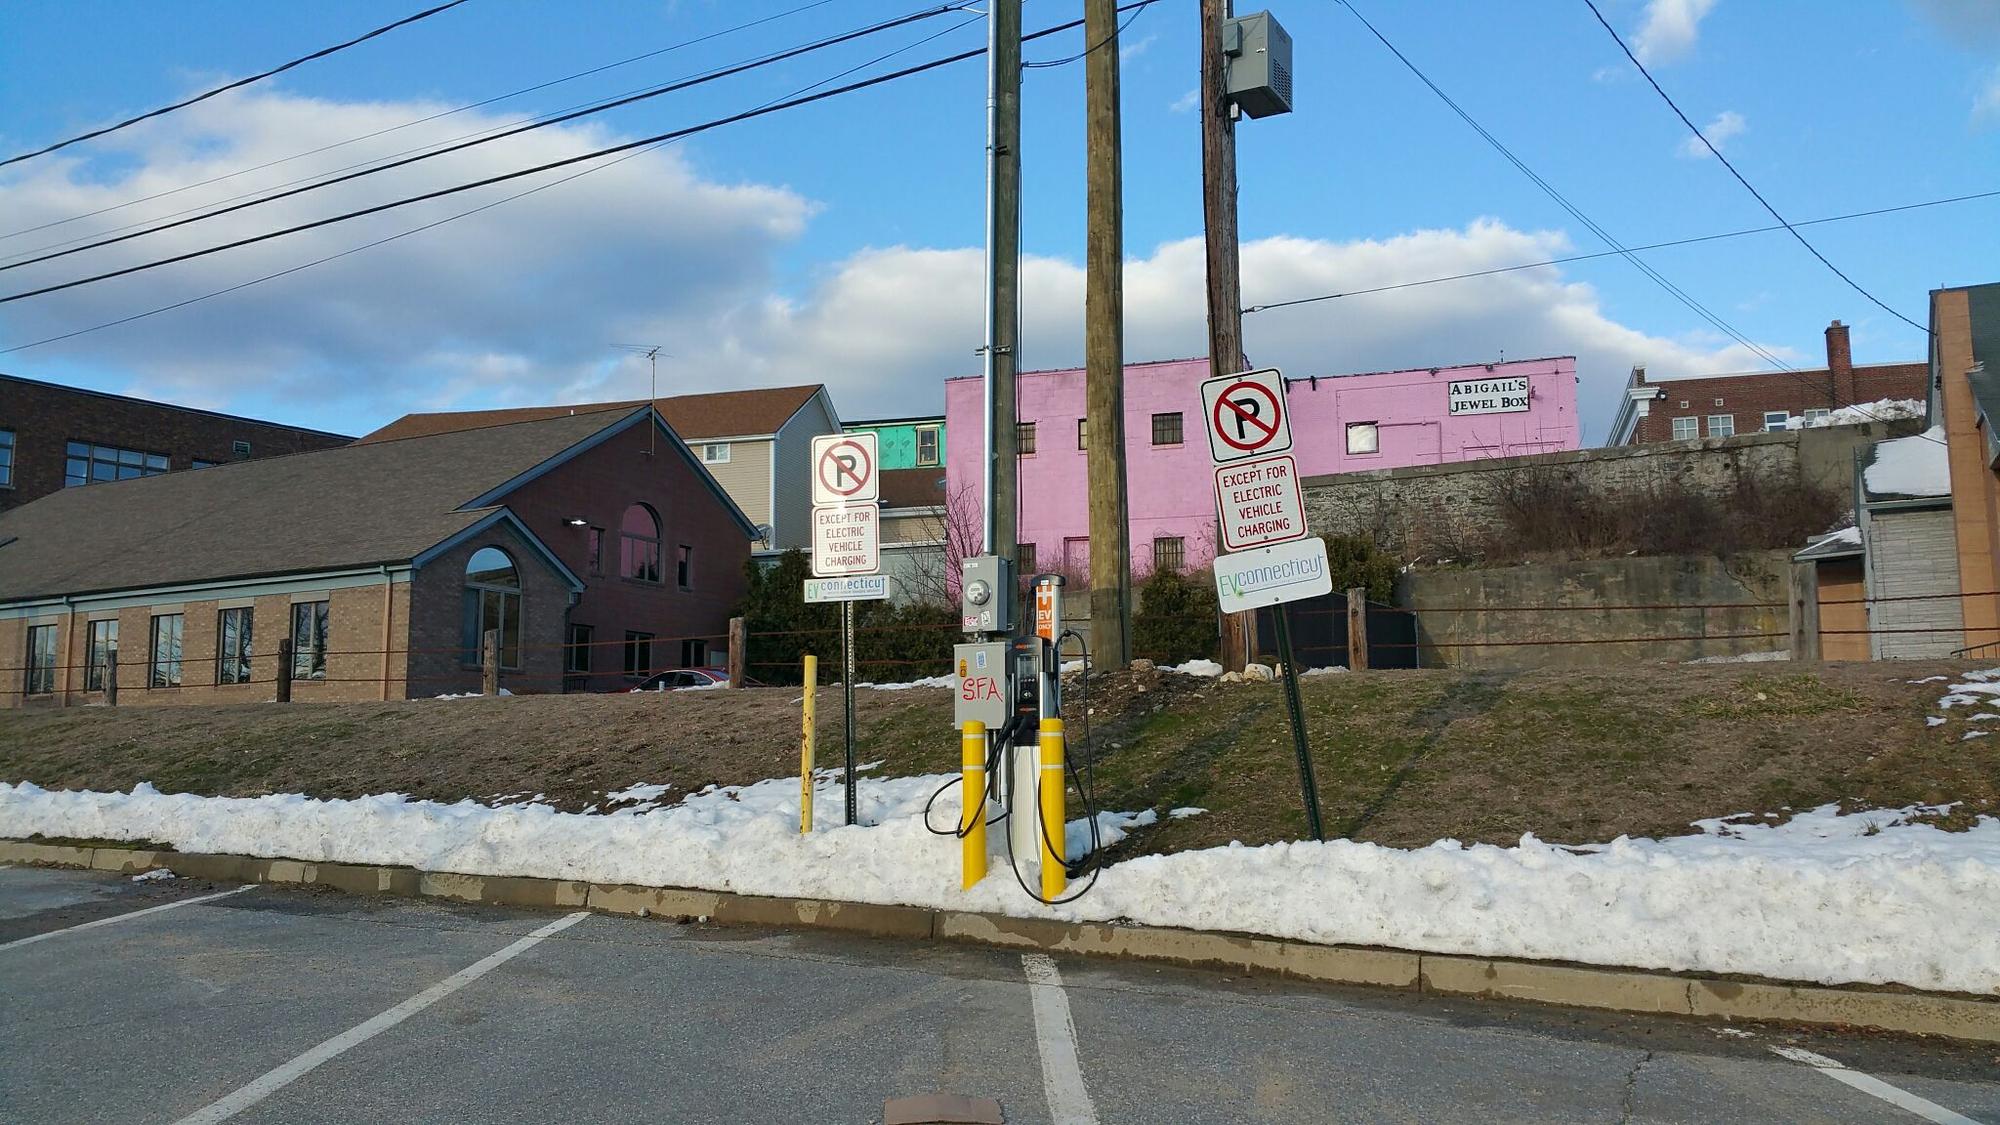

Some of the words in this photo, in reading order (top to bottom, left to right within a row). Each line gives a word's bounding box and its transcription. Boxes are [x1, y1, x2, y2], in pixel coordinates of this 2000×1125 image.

[1451, 380, 1527, 395] ABIGAIL'S
[1451, 399, 1497, 413] JEWEL
[1501, 396, 1528, 408] BOX
[1233, 397, 1260, 440] P
[836, 454, 857, 488] P
[1223, 469, 1262, 488] EXCEPT
[1266, 465, 1287, 480] FOR
[1233, 483, 1283, 504] ELECTRIC
[819, 512, 851, 525] EXCEPT
[854, 511, 871, 522] FOR
[1238, 501, 1284, 520] VEHICLE
[826, 526, 865, 539] ELECTRIC
[1237, 517, 1290, 539] CHARGING
[828, 540, 863, 553] VEHICLE
[825, 554, 867, 567] CHARGING
[1038, 609, 1052, 620] EV
